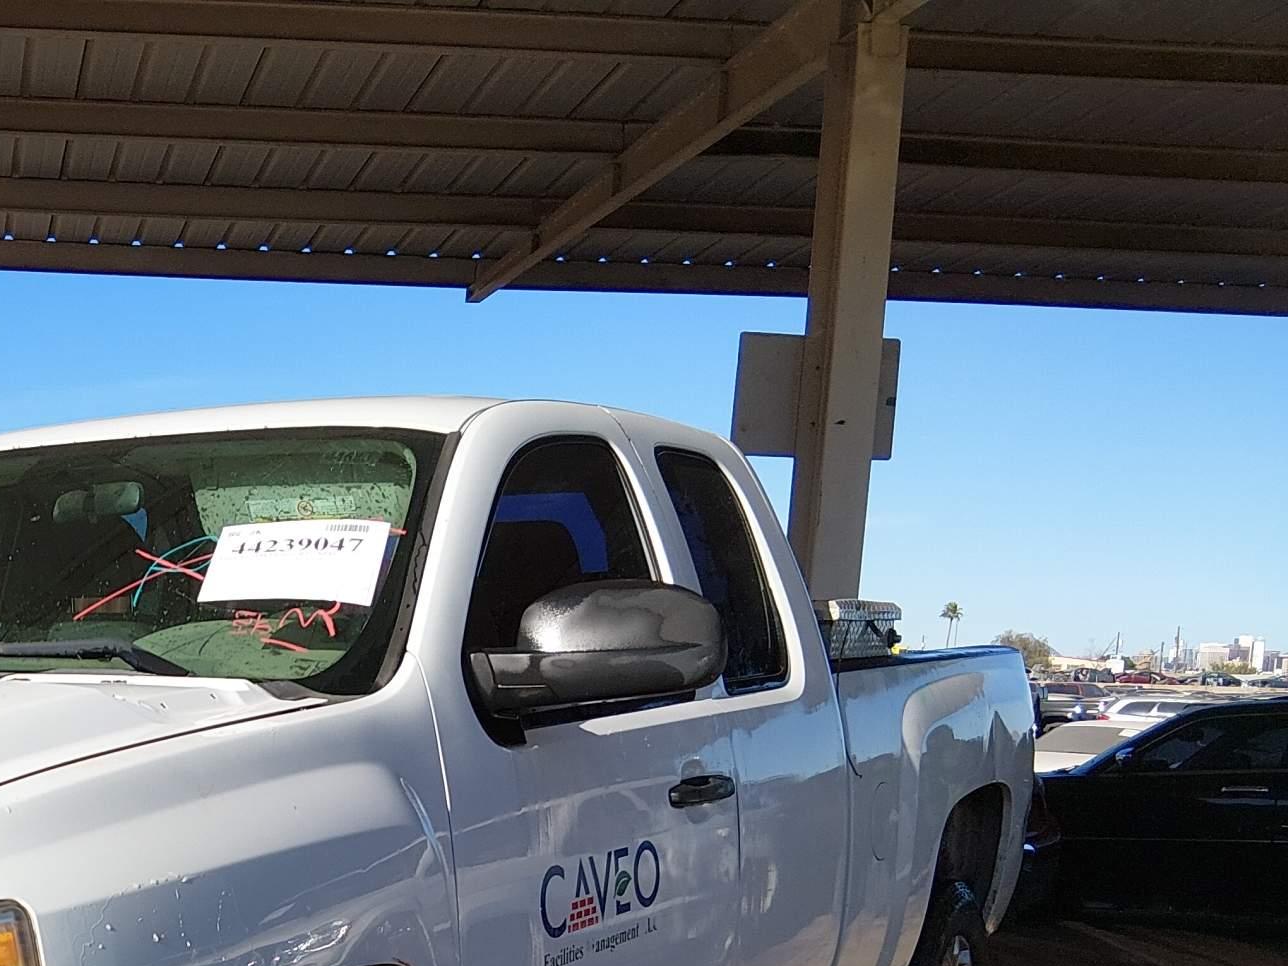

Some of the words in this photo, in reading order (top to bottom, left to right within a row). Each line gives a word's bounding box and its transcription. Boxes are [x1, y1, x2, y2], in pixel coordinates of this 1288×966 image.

[232, 537, 364, 554] 44239047
[540, 840, 660, 938] CAVEO
[592, 923, 640, 953] anagement
